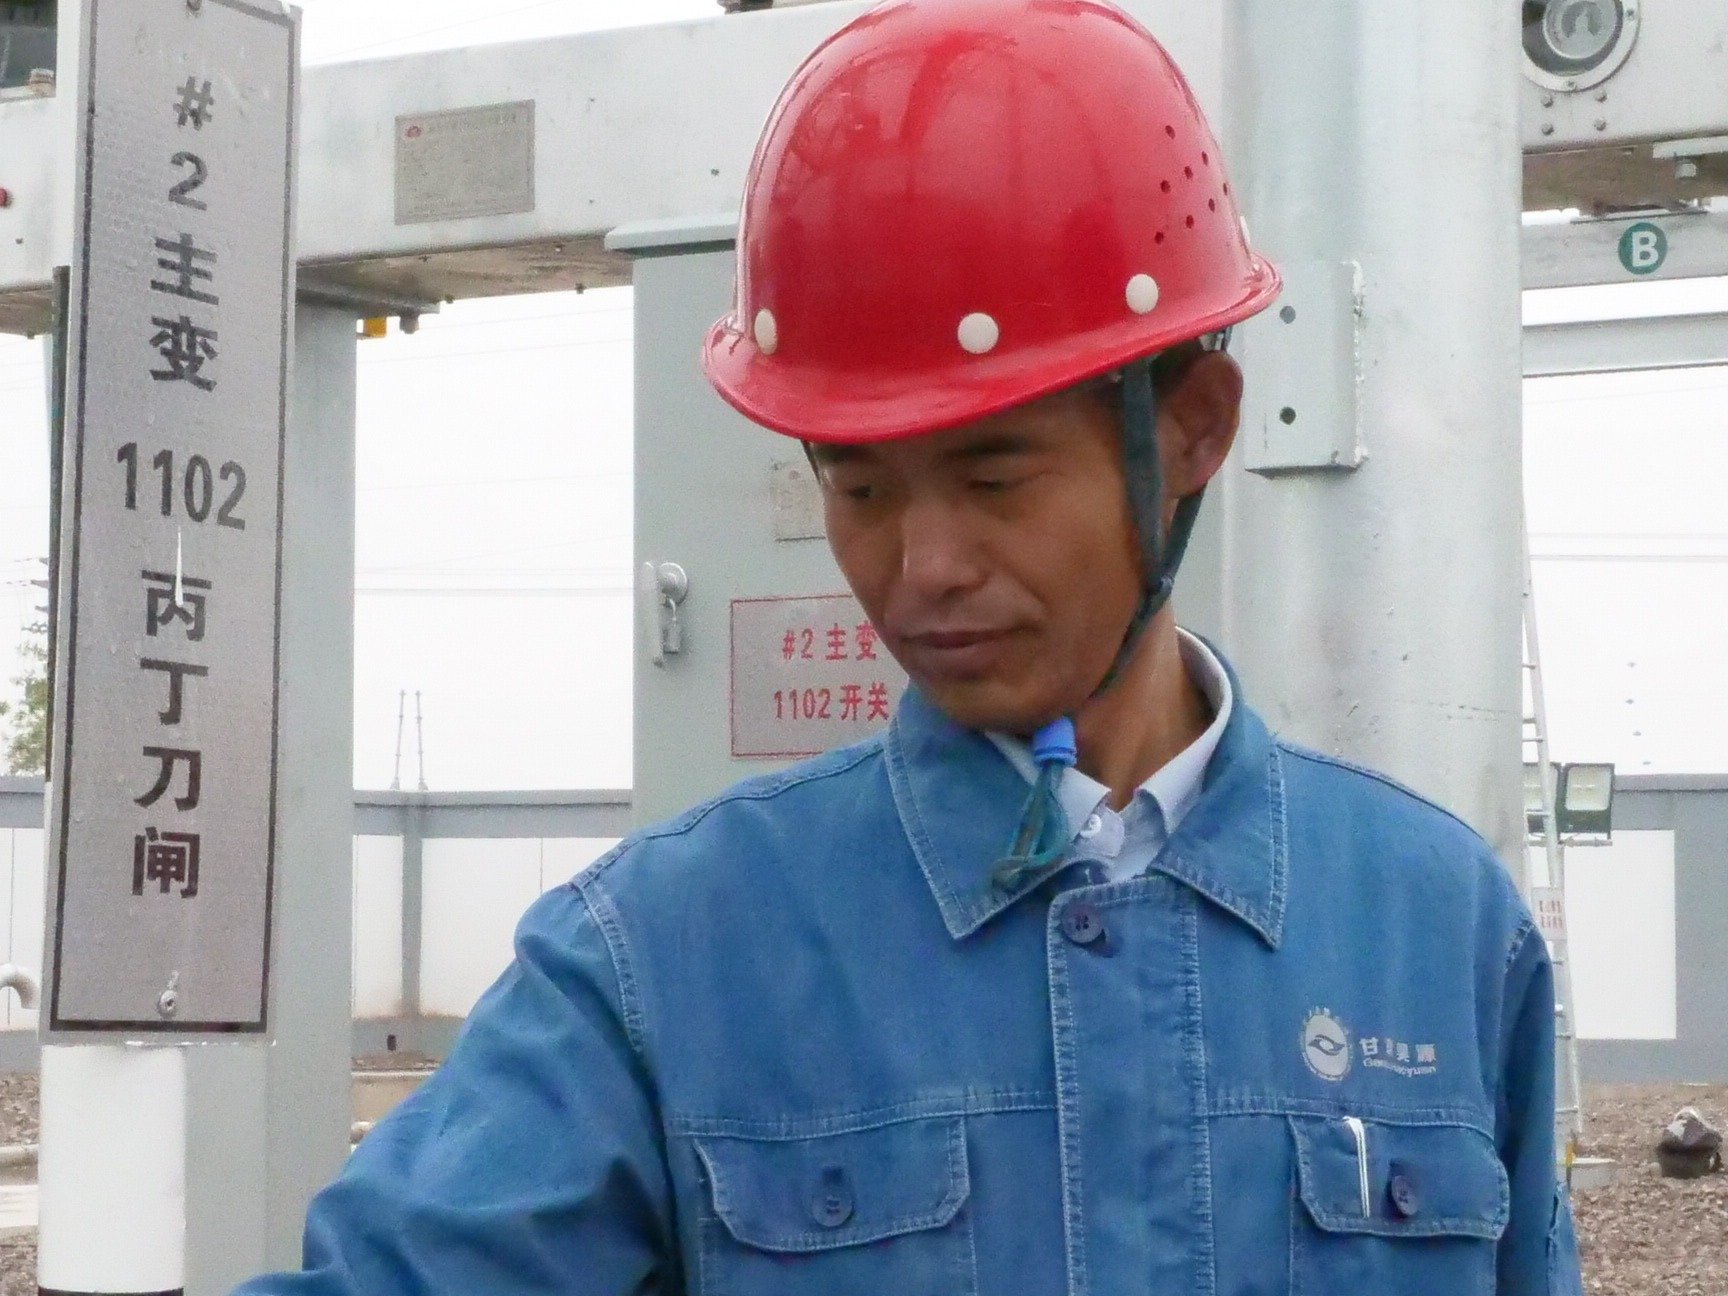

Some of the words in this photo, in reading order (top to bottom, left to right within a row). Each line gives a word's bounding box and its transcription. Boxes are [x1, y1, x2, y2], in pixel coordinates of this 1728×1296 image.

[147, 75, 220, 394] #2主变
[1631, 230, 1659, 268] B
[115, 440, 248, 532] 1102
